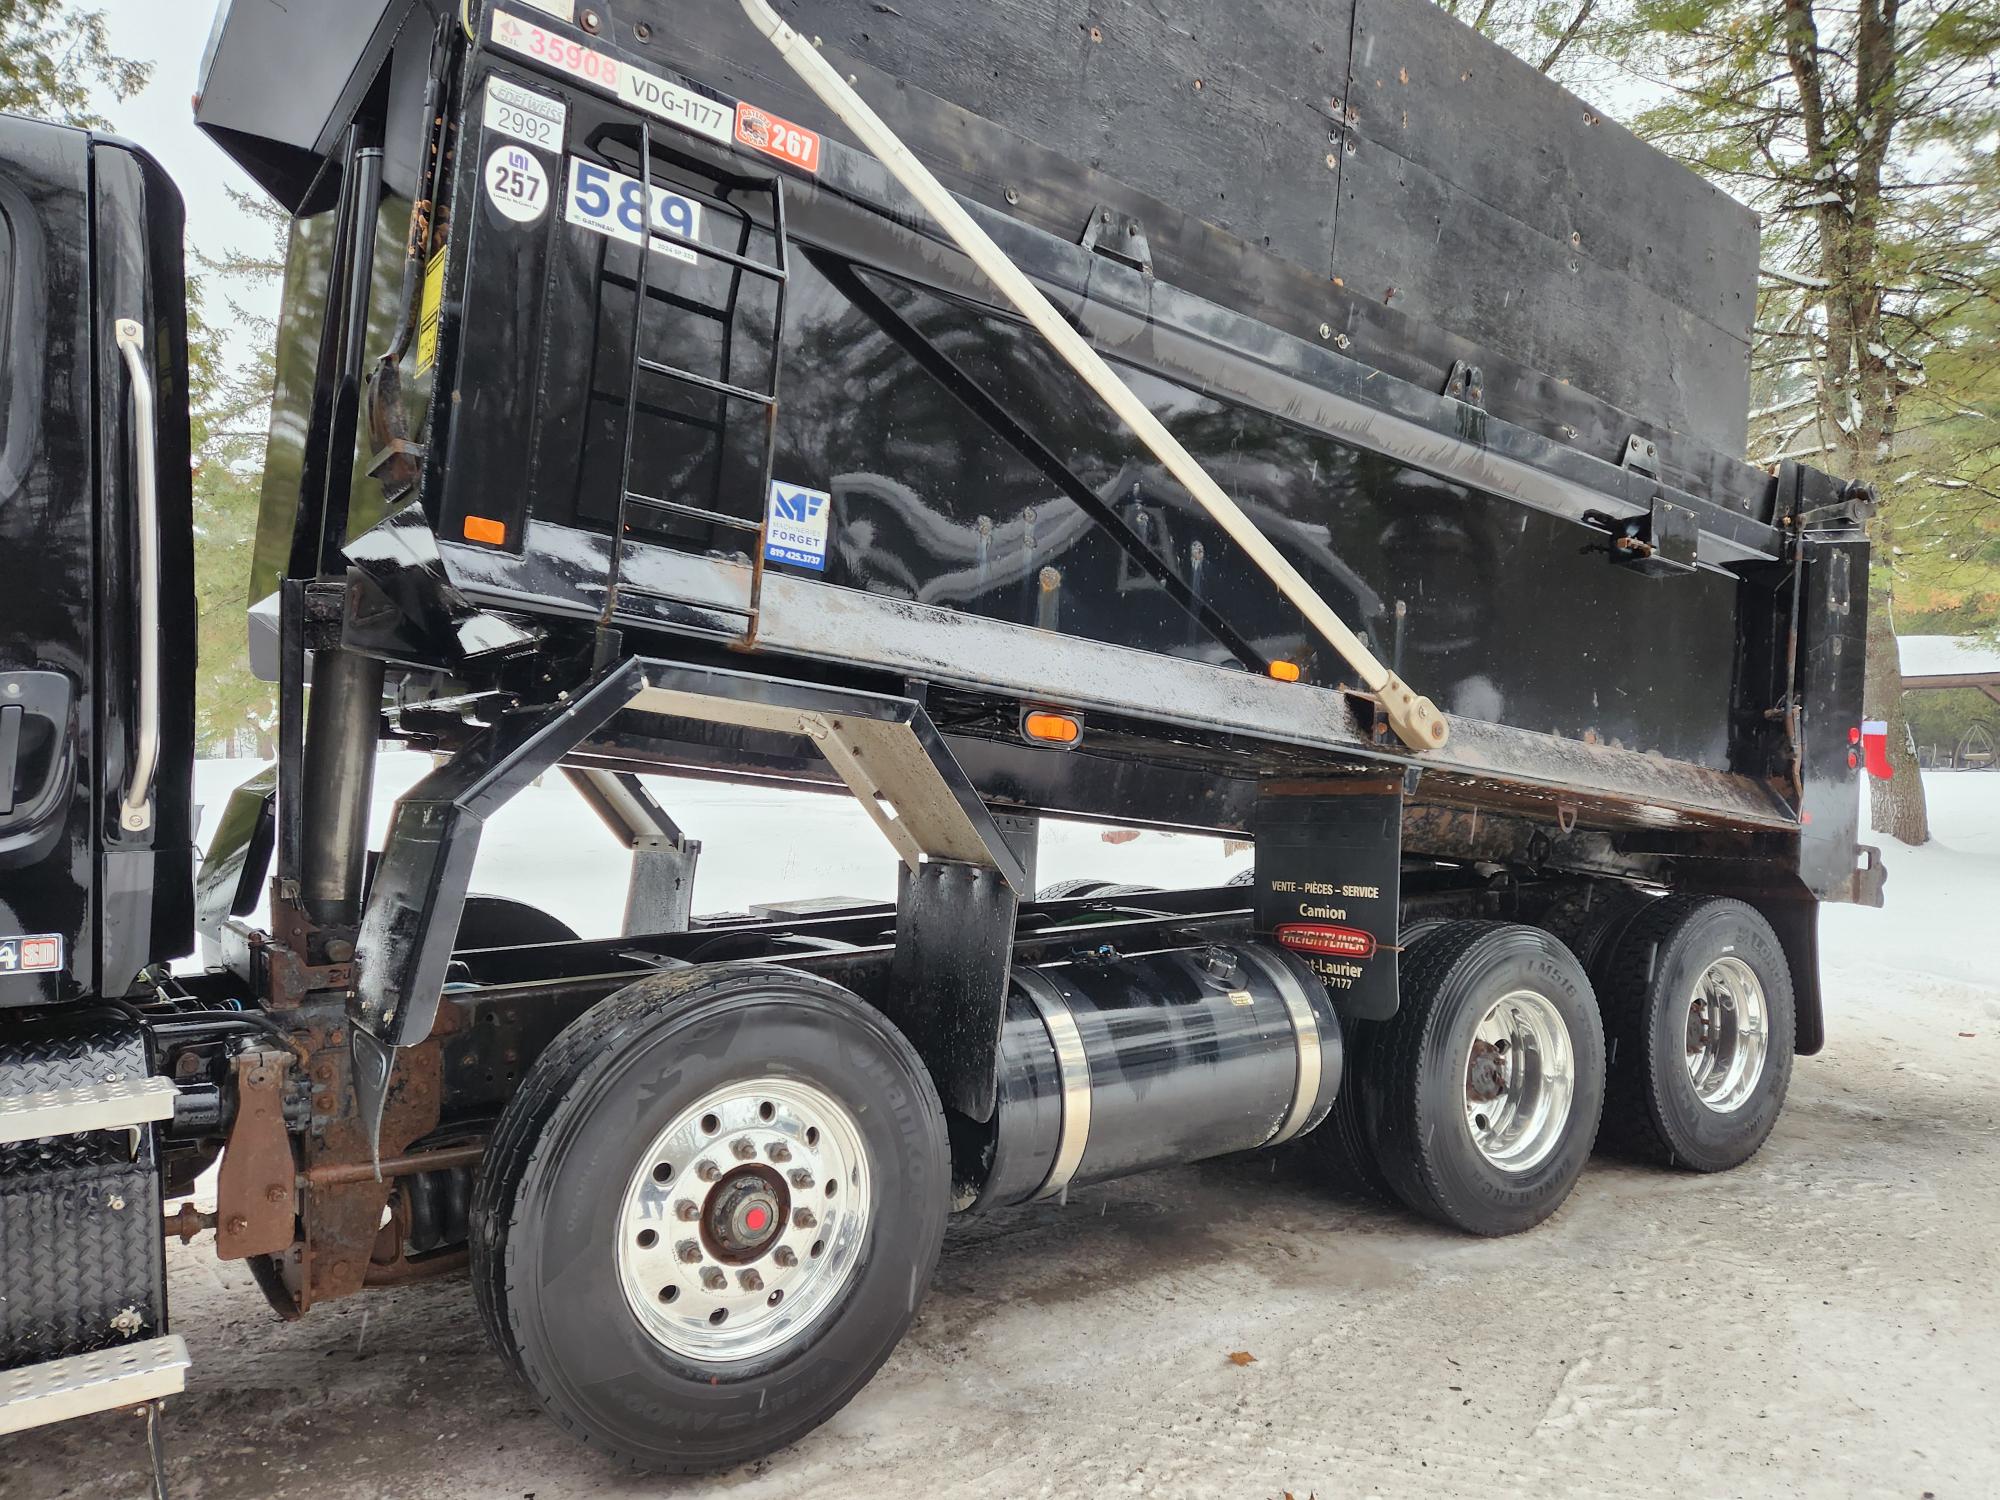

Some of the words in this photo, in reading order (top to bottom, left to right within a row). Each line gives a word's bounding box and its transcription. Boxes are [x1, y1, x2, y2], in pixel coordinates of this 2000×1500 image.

[529, 28, 618, 86] 35908
[497, 88, 563, 119] EDELWEISS
[631, 75, 723, 130] VDG-1177
[498, 107, 551, 145] 2992
[771, 123, 814, 162] 267
[495, 165, 540, 202] 257
[575, 161, 693, 238] 589
[582, 217, 615, 232] GATINEAU
[772, 529, 821, 548] FORGET
[1271, 880, 1297, 892] VENTE
[1304, 880, 1334, 896] PIÈCES
[1342, 885, 1380, 899] SERVICE
[1299, 903, 1347, 920] Camion
[1281, 930, 1366, 952] FREIGHTLINER
[1305, 959, 1363, 978] t-Laurier
[1318, 975, 1352, 990] 3-7177
